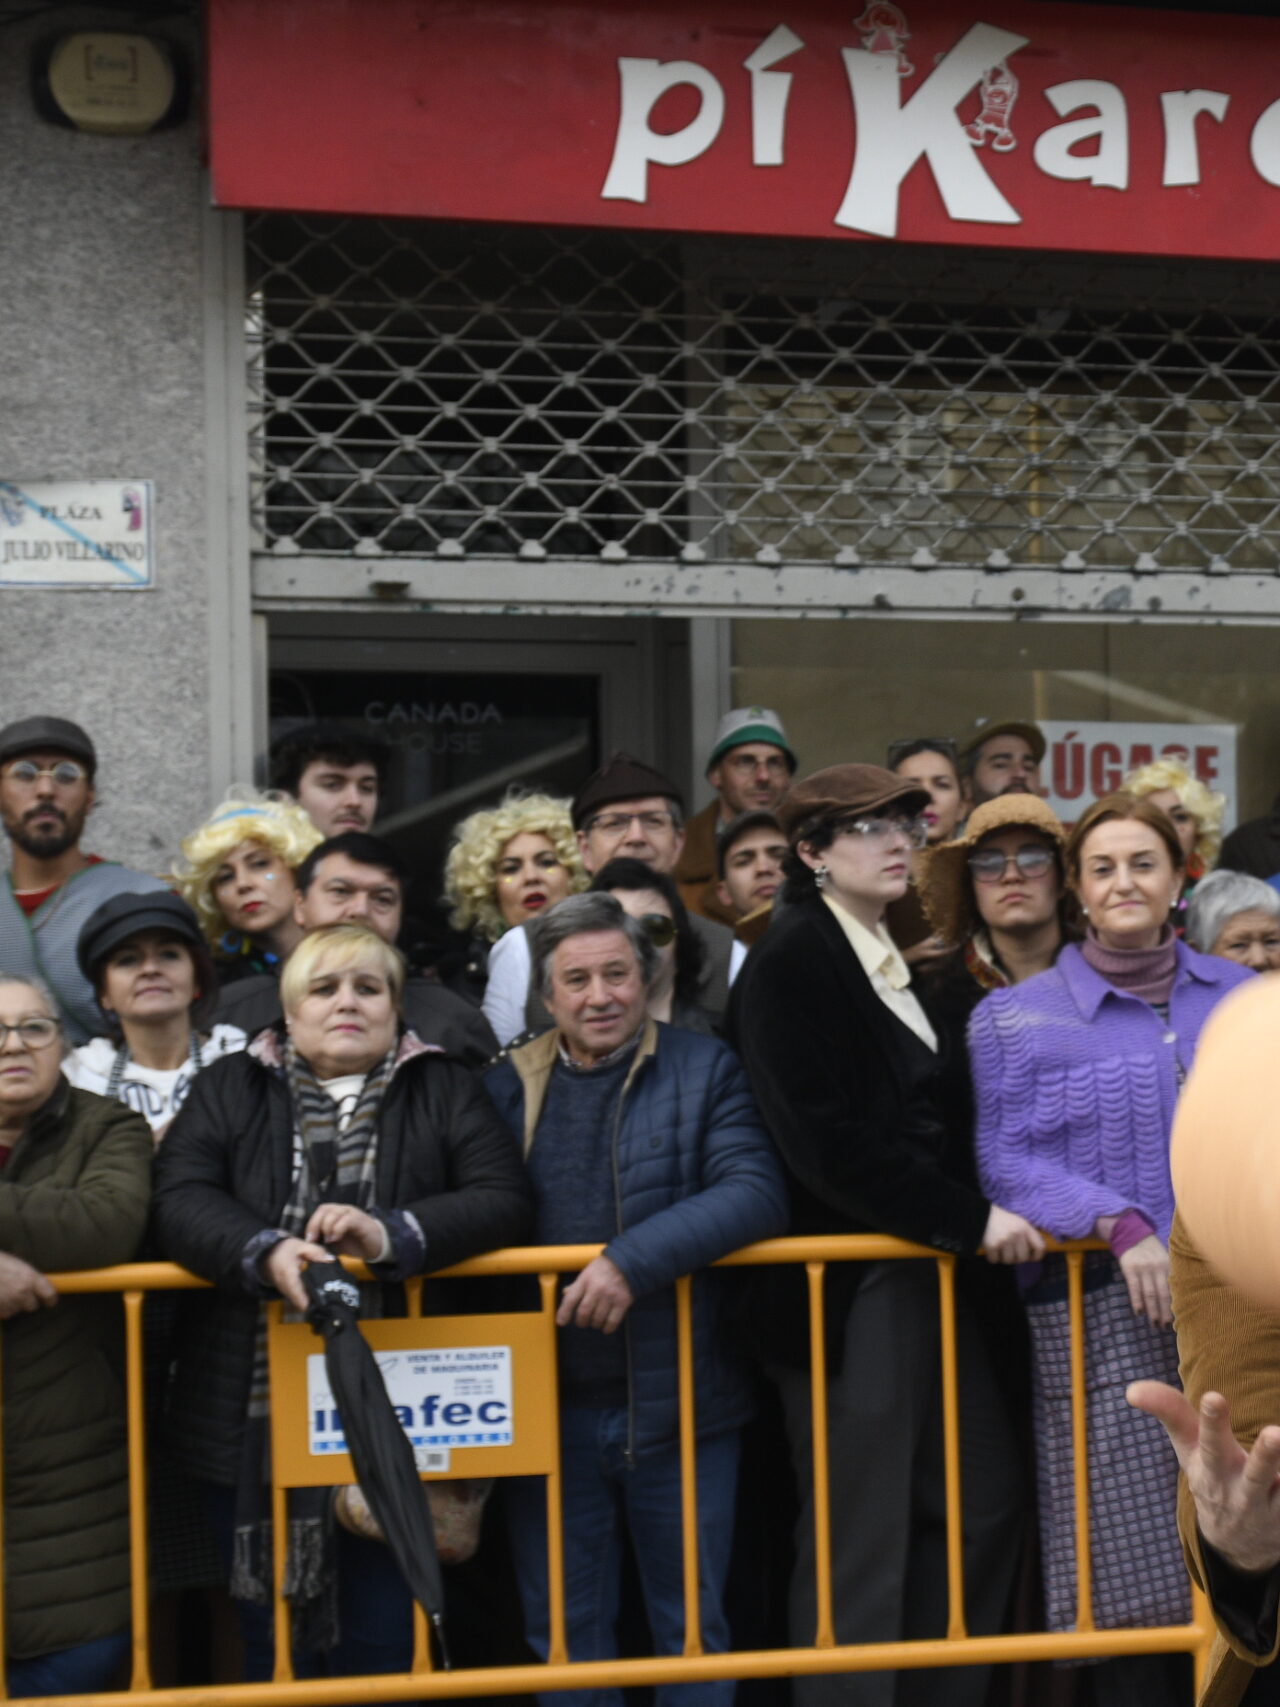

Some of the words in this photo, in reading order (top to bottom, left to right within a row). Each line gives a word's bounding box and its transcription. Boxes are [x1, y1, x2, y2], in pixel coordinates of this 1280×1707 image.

[40, 504, 102, 520] PLAZA
[3, 540, 52, 564] JULIO
[55, 540, 144, 561] VILLARINO
[363, 702, 502, 725] CANADA
[315, 1394, 507, 1432] iafec
